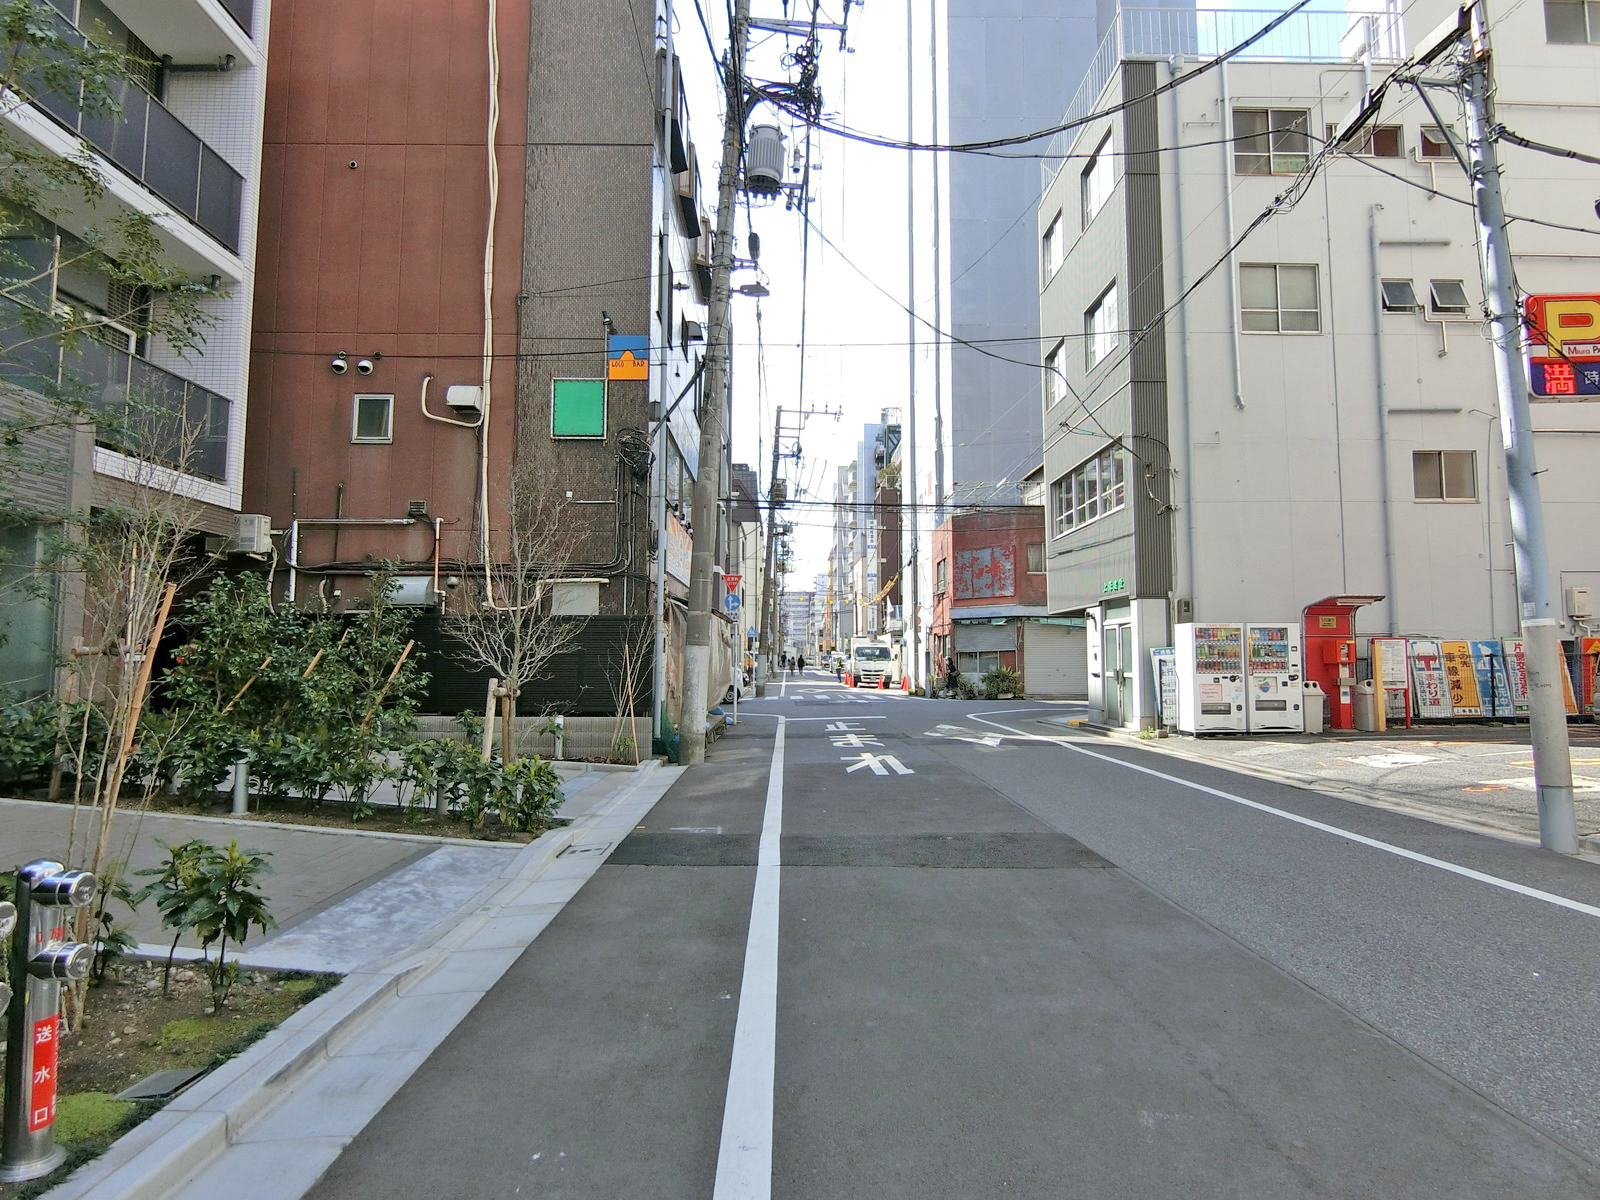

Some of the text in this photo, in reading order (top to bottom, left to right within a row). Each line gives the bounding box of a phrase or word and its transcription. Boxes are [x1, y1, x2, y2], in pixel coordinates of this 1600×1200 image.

[1544, 299, 1600, 358] P
[1543, 364, 1576, 394] 満
[1444, 652, 1464, 705] 車線減少
[1457, 645, 1471, 668] この先
[1425, 673, 1441, 706] まわり道
[825, 721, 915, 776] 止まれ
[34, 1026, 53, 1125] 送水口
